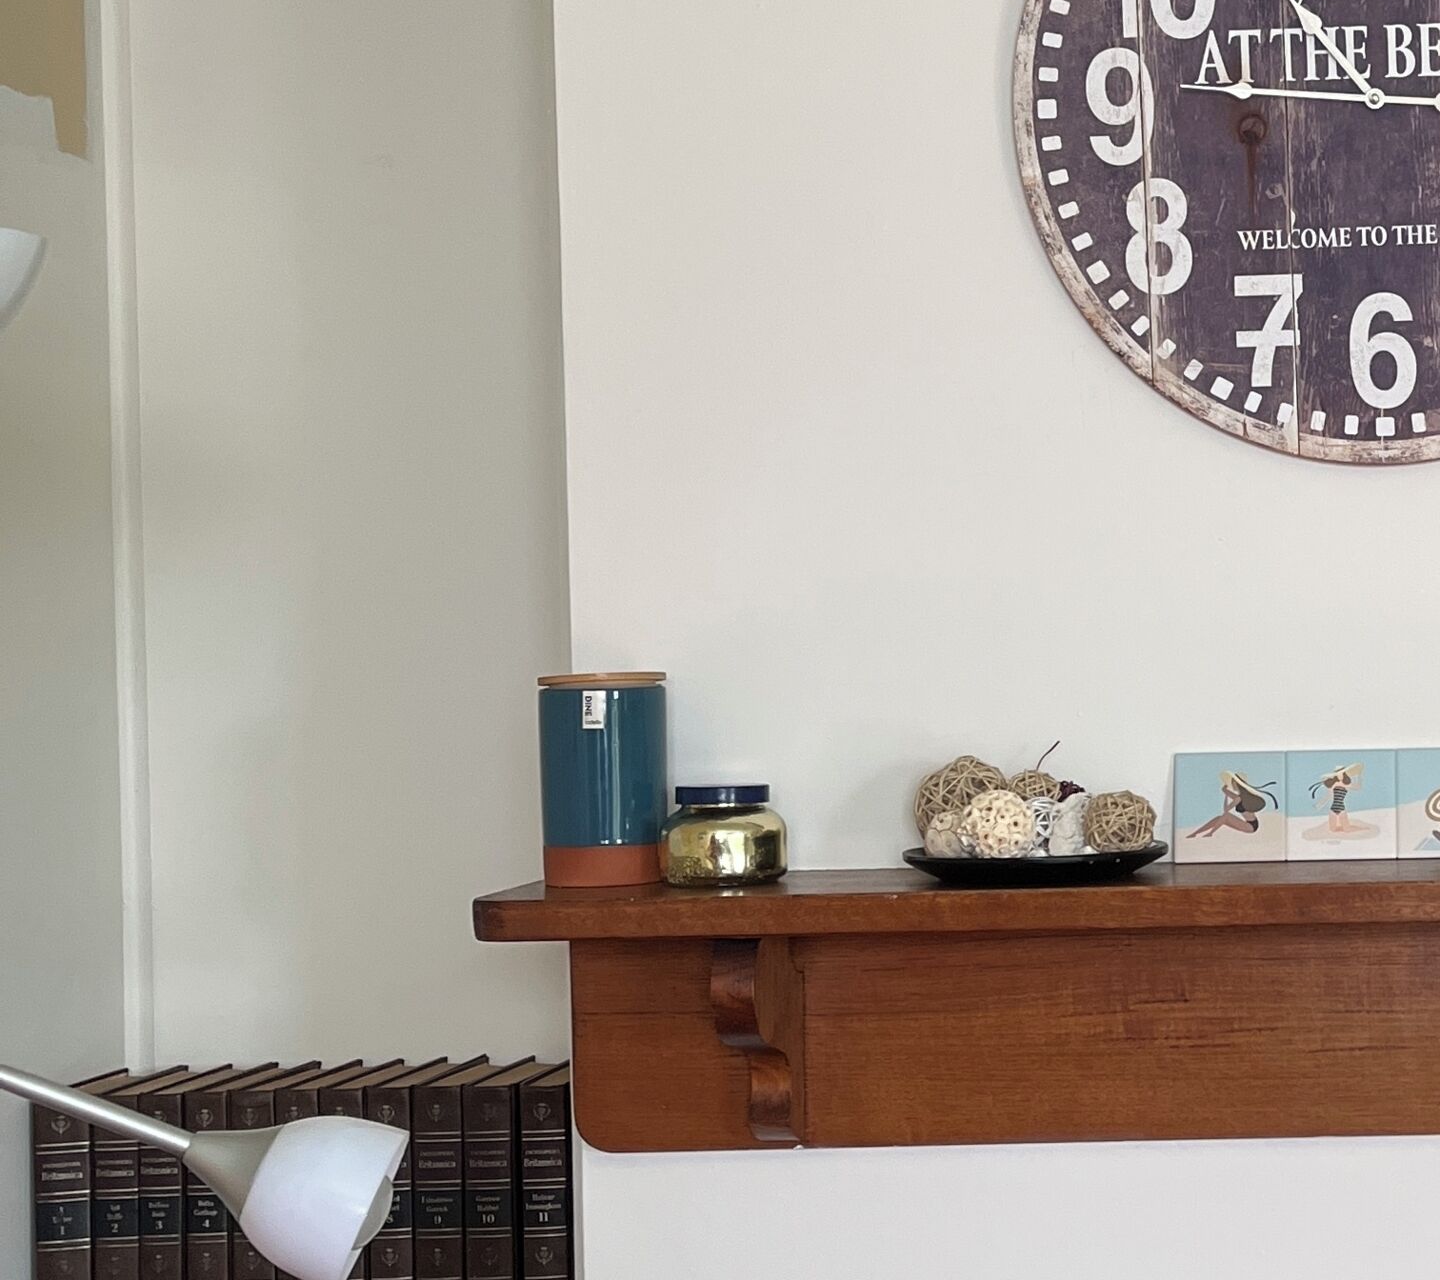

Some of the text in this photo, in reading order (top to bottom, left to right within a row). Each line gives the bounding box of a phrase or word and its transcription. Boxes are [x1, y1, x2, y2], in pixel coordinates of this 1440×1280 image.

[1194, 28, 1262, 84] AT
[1269, 24, 1372, 82] THE
[1085, 47, 1154, 166] 9
[1125, 178, 1193, 296] 8
[1237, 227, 1352, 251] WELCOME
[1356, 225, 1388, 247] TO
[1391, 223, 1439, 246] THE
[1234, 272, 1303, 388] 7
[1348, 291, 1417, 410] 6
[584, 695, 593, 717] DINE
[482, 1213, 495, 1224] 10
[538, 1211, 549, 1223] 11
